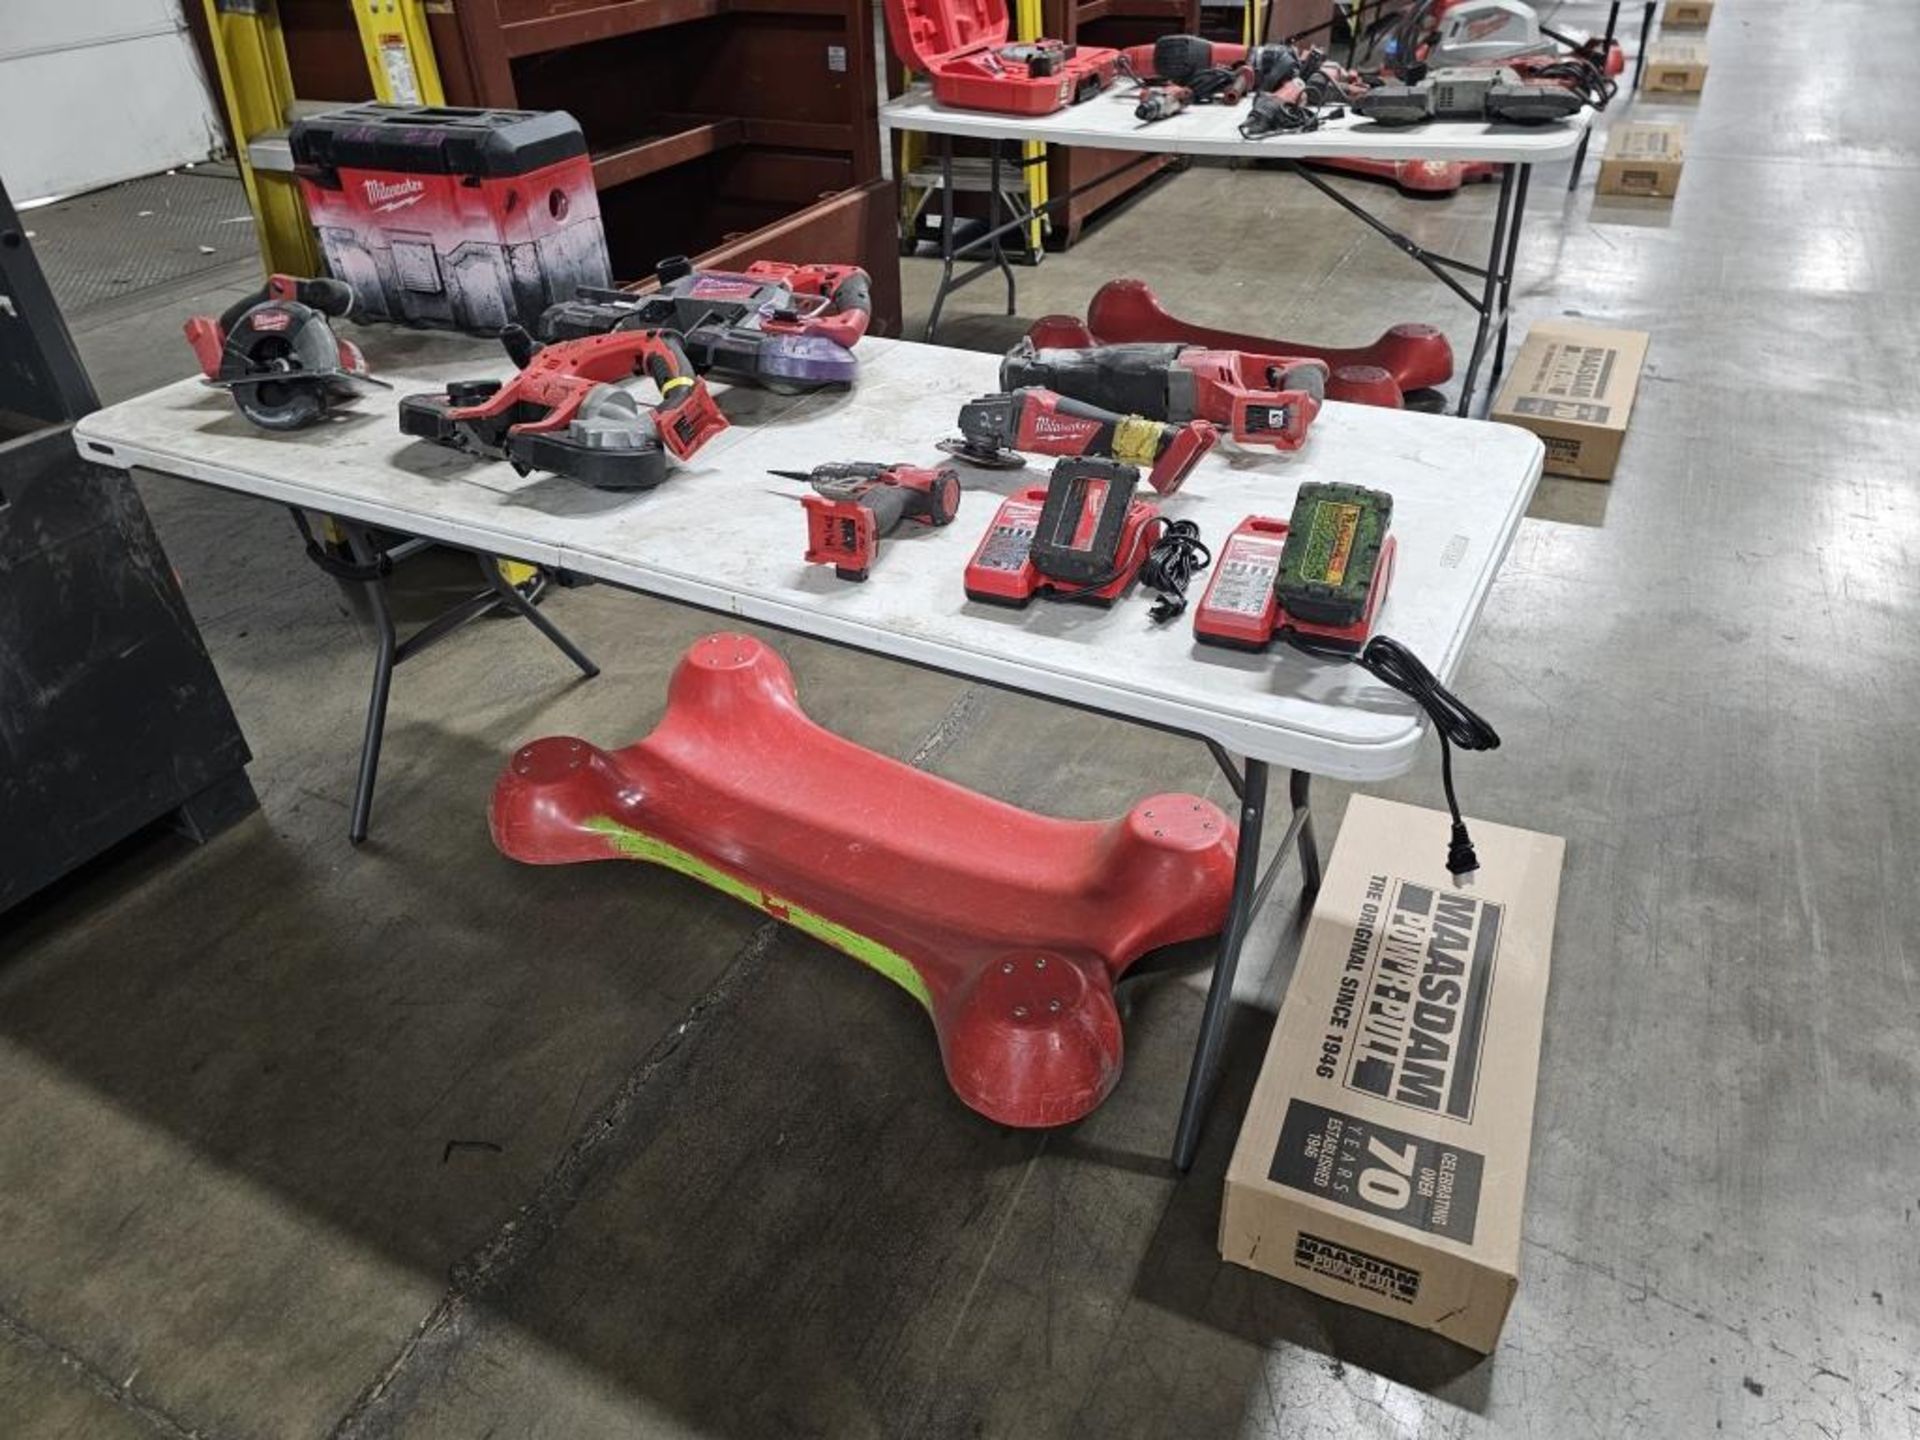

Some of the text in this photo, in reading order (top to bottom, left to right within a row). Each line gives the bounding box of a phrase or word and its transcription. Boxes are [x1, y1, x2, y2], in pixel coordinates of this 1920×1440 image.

[1316, 875, 1388, 1079] THE ORIGINAL SINCE 1946
[1395, 892, 1477, 1111] MAASDAM
[1304, 1133, 1322, 1158] 1946
[1313, 1117, 1343, 1187] ESTABLISHED
[1358, 1136, 1418, 1210] 70
[1416, 1167, 1437, 1198] OVER
[1431, 1152, 1458, 1225] CELEBRATING
[1296, 1239, 1419, 1287] MAASDAM
